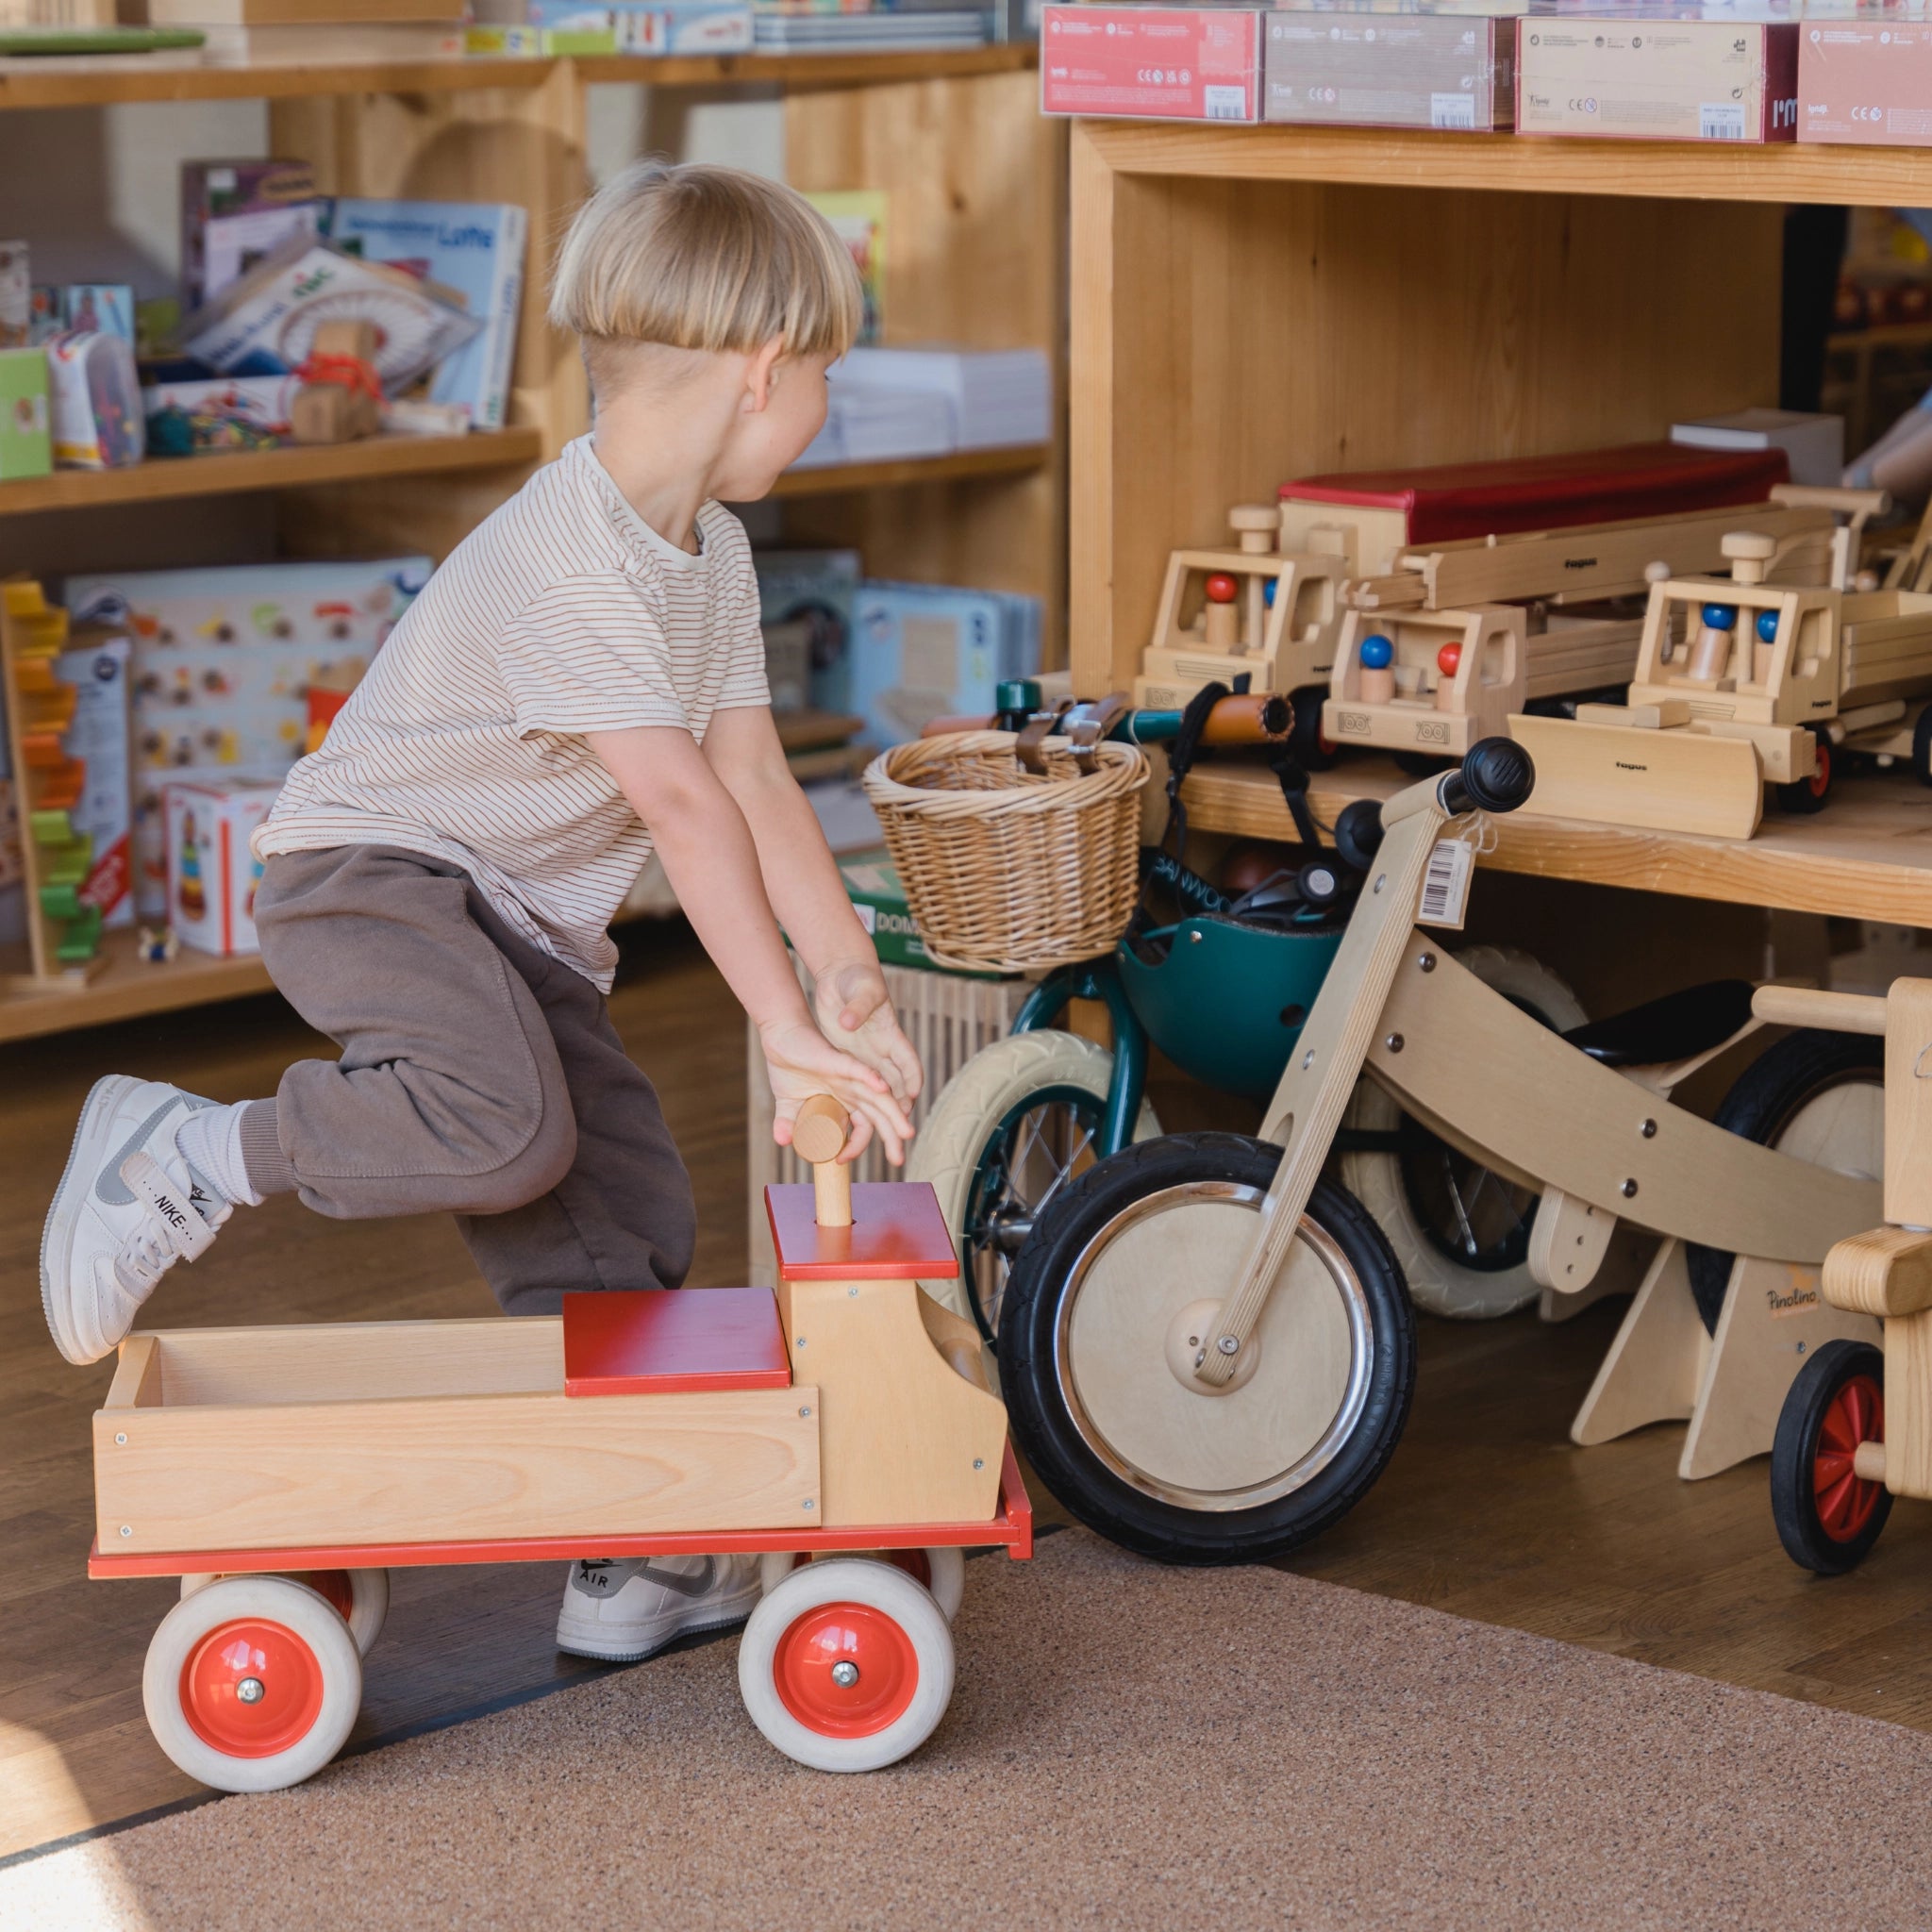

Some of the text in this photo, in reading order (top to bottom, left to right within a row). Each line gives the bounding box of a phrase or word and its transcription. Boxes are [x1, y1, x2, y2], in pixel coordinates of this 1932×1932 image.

[154, 1195, 187, 1228] NIKE
[1767, 1288, 1817, 1309] Pinolino
[579, 1568, 609, 1589] AIR
